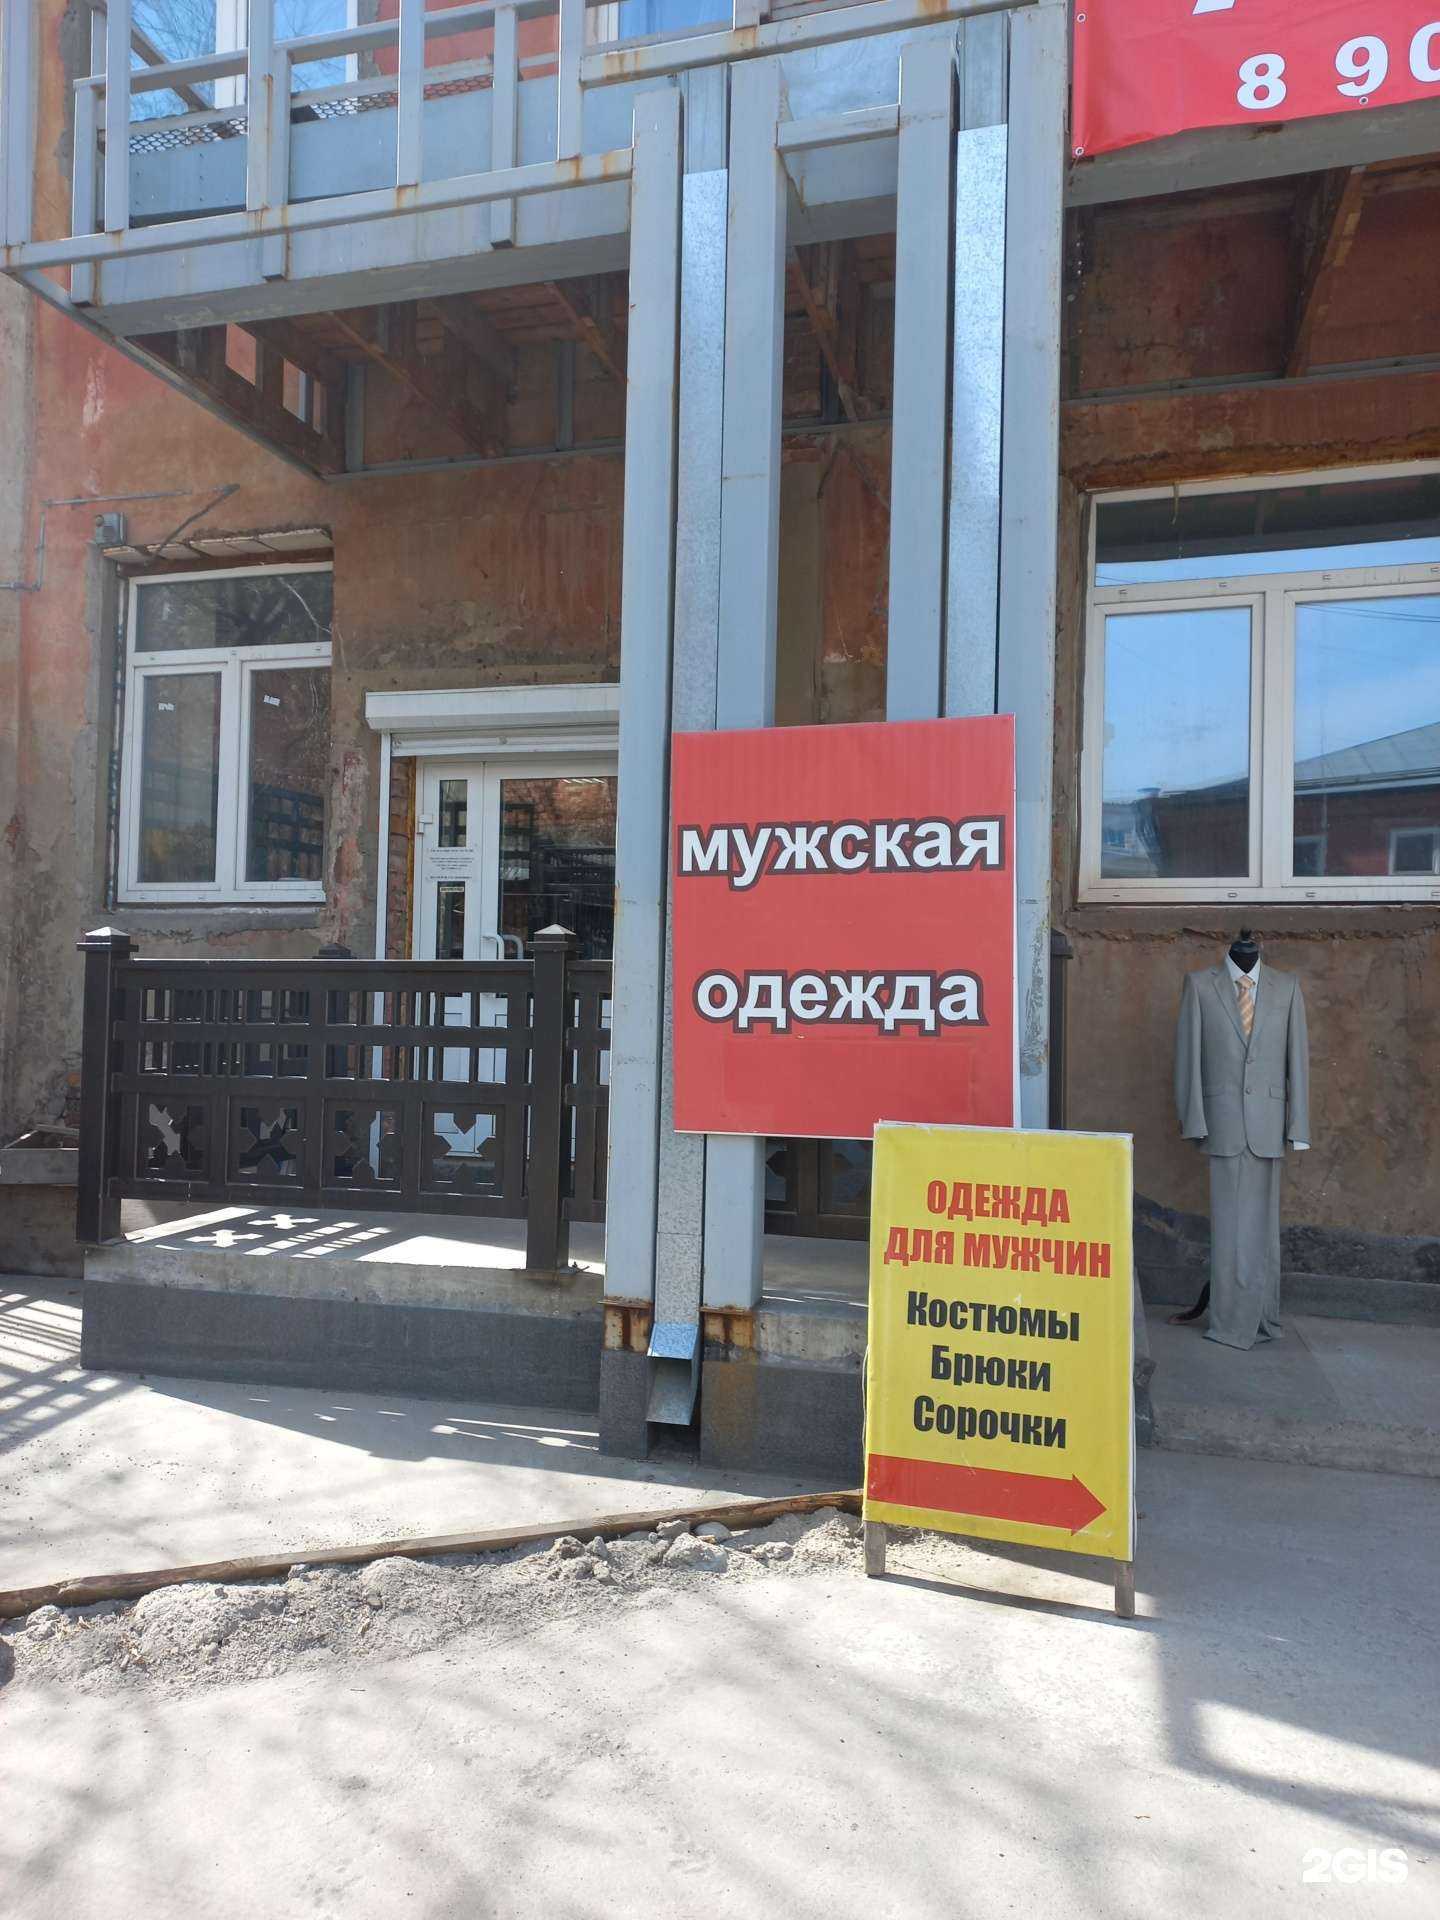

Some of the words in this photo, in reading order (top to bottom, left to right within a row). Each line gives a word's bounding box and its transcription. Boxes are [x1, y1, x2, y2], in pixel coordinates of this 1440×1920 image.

[1236, 52, 1288, 111] 8
[680, 818, 1002, 889] мужская
[695, 971, 985, 1034] одежда
[926, 1180, 1071, 1227] ОДЕЖДА
[884, 1227, 954, 1266] ДЛЯ
[963, 1232, 1111, 1279] МУЖЧИН
[907, 1291, 1080, 1342] Костюмы
[931, 1344, 1051, 1392] Брюки
[913, 1395, 1066, 1449] Сорочки
